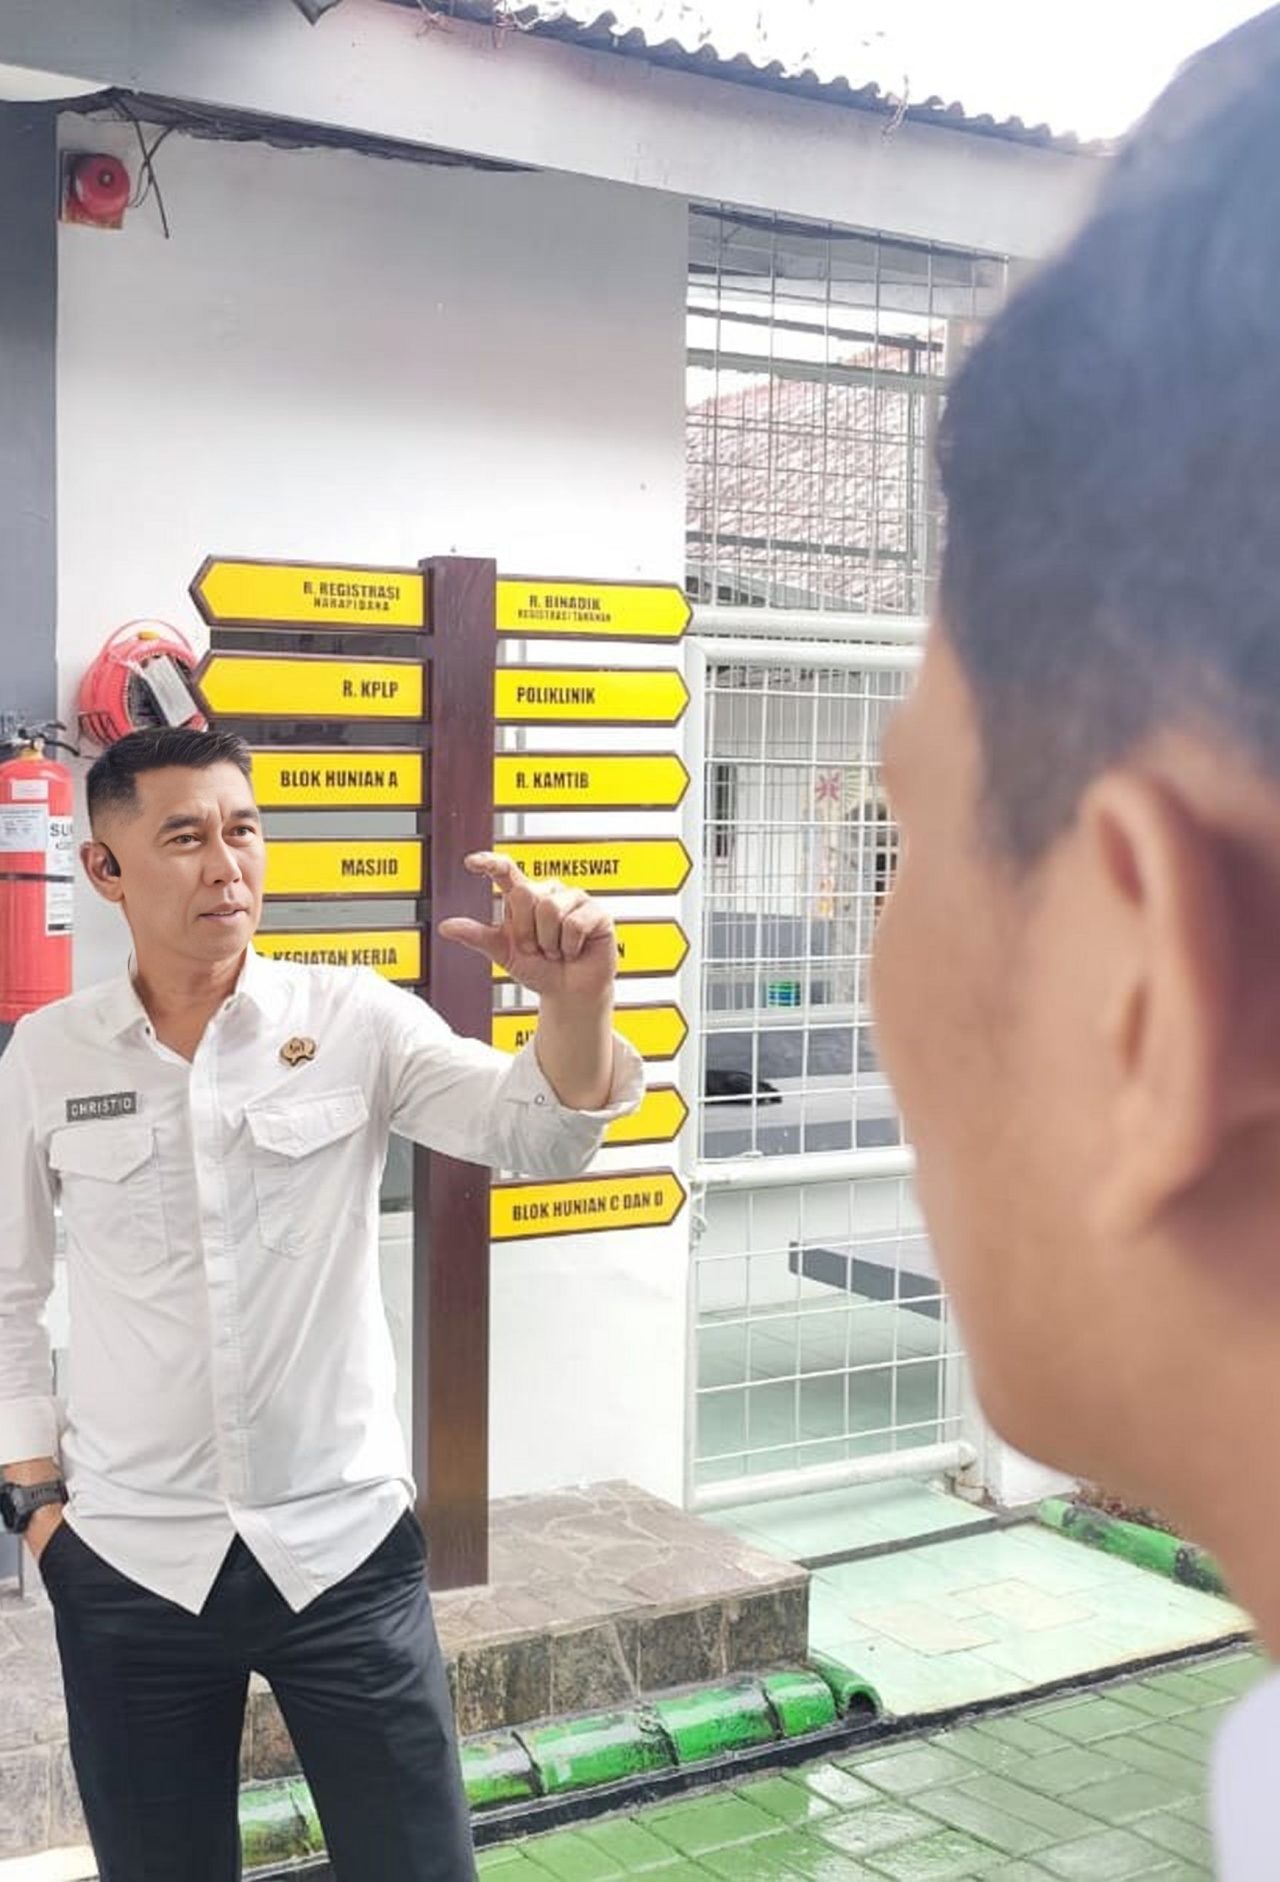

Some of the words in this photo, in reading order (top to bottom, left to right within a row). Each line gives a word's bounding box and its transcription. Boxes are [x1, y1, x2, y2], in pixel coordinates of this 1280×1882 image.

[319, 582, 400, 601] REGISTRASI
[545, 595, 601, 611] BINADIK
[343, 680, 357, 697] R.
[361, 680, 399, 699] KPLP
[517, 686, 596, 705] POLIKLINIK
[280, 770, 321, 788] BLOK
[326, 770, 384, 788] HUNIAN
[388, 771, 399, 788] A
[516, 772, 529, 789] R.
[533, 771, 589, 789] KAMTIB
[341, 858, 399, 877] MASJID
[533, 859, 620, 877] BIMKESWAT
[352, 947, 398, 965] KERJA
[512, 1203, 551, 1221] BLOK
[552, 1197, 606, 1217] HUNIAN
[610, 1195, 620, 1211] C
[623, 1191, 652, 1210] DAN
